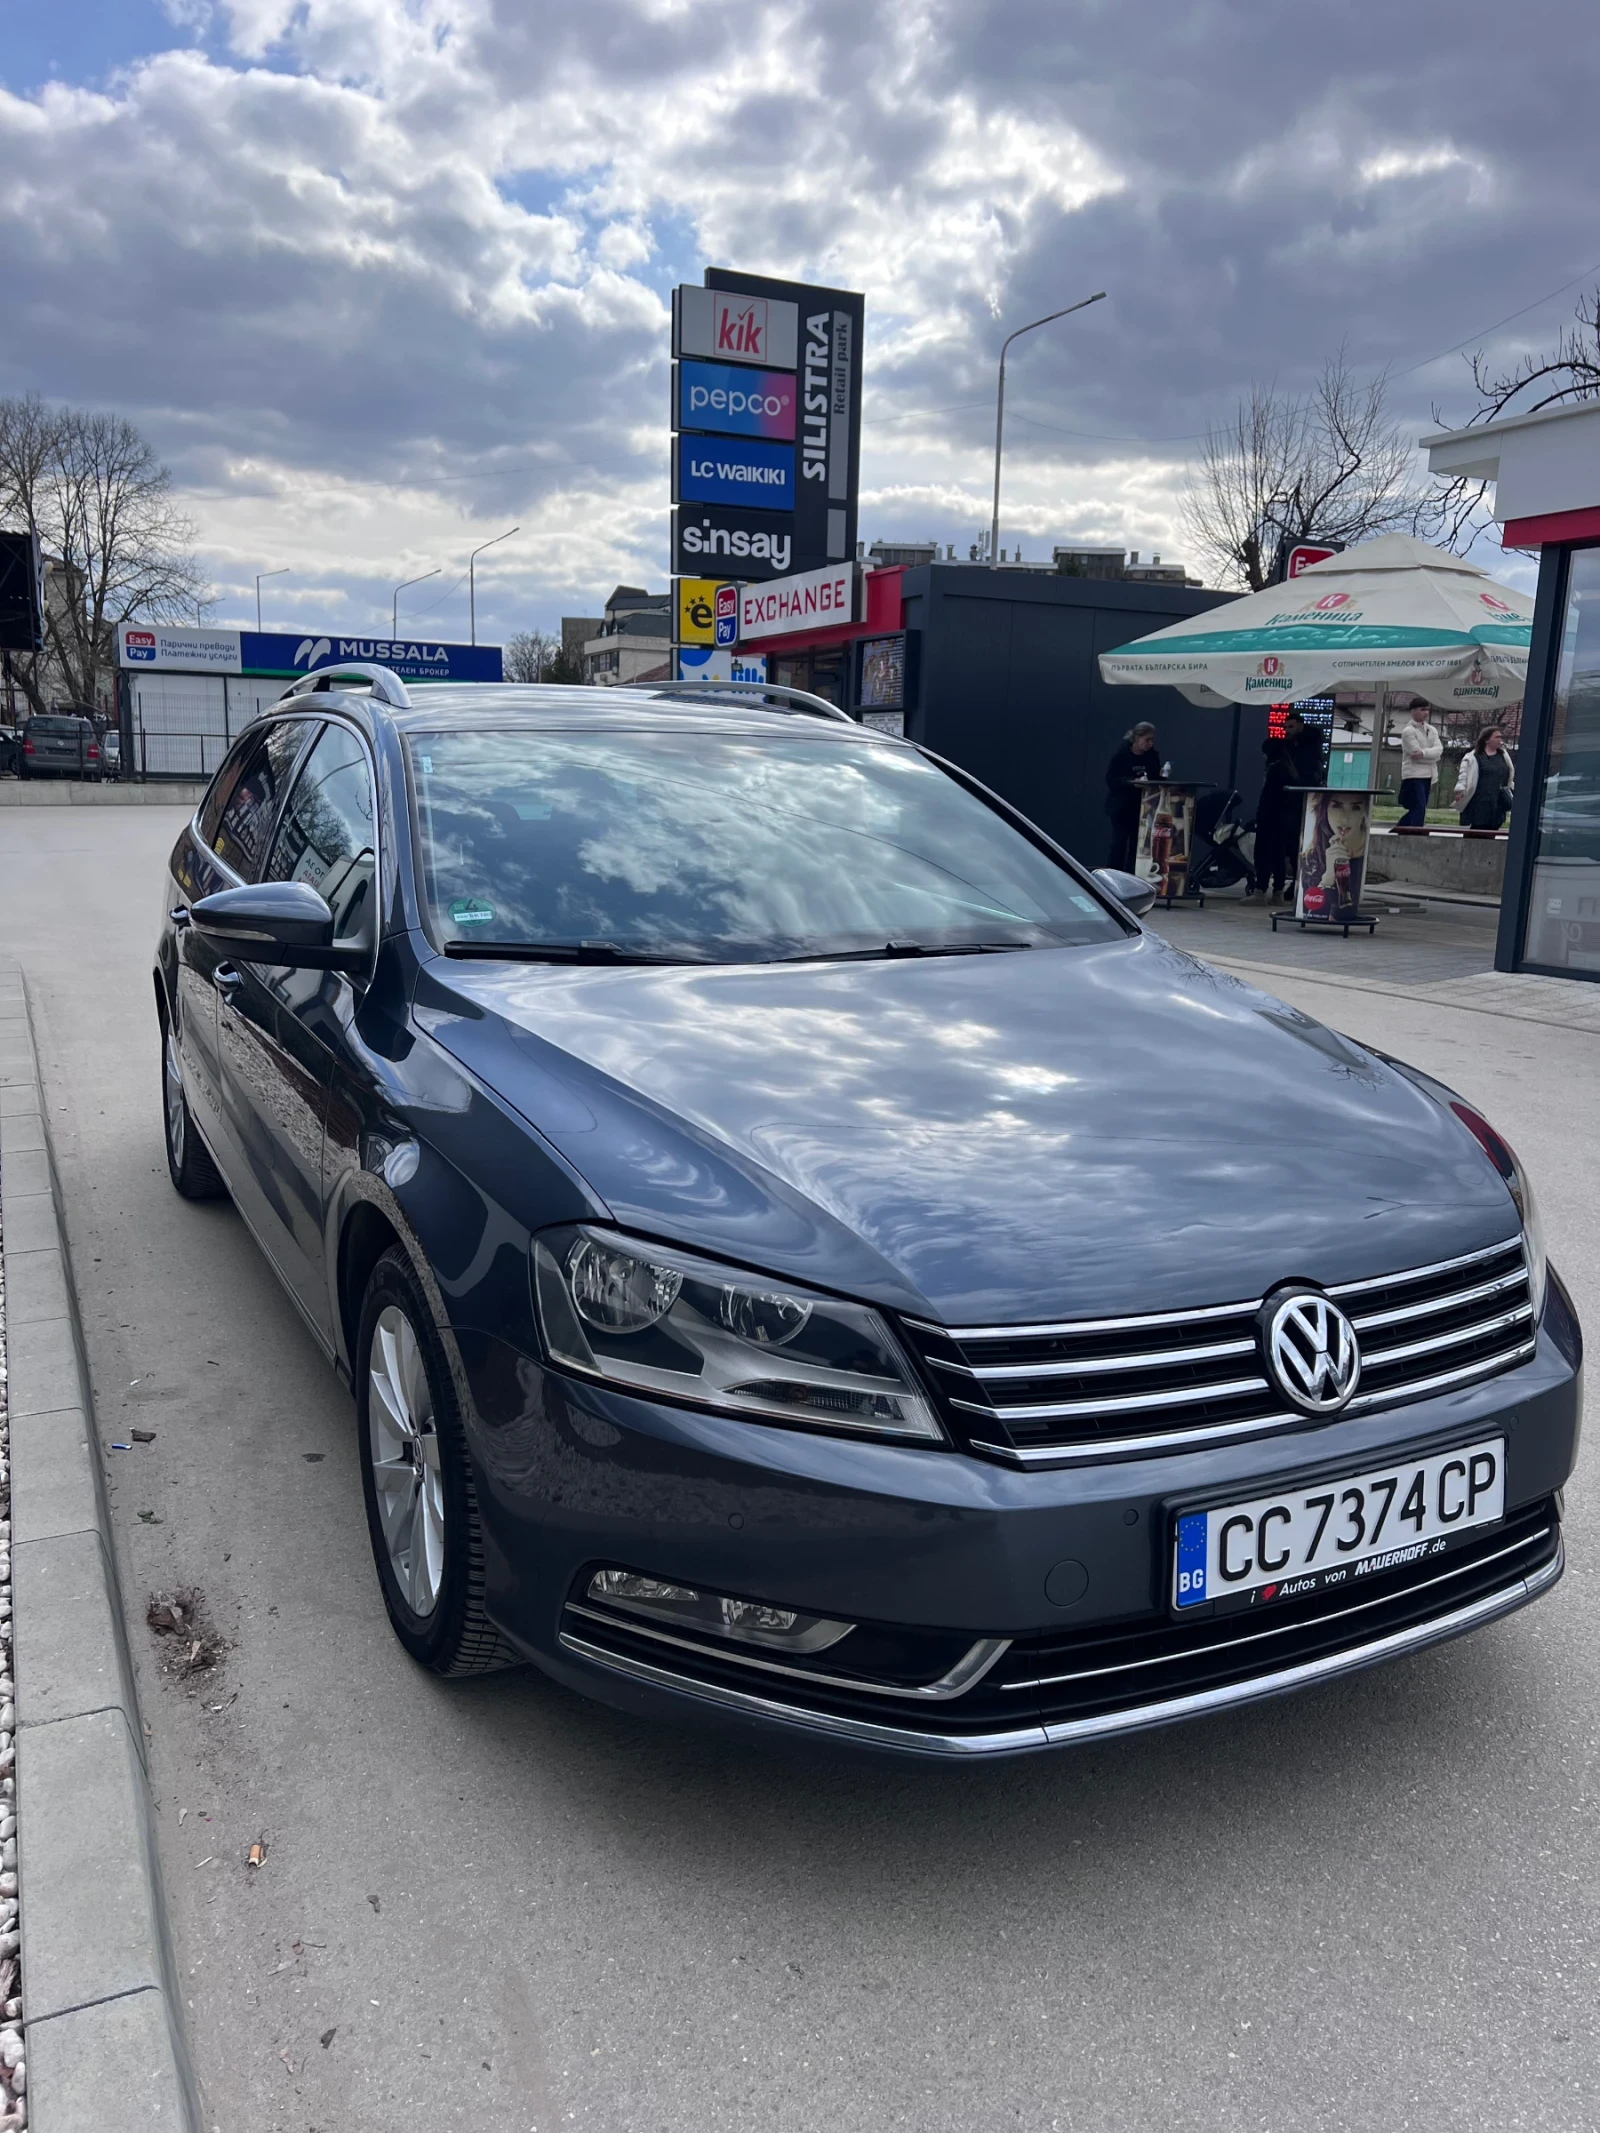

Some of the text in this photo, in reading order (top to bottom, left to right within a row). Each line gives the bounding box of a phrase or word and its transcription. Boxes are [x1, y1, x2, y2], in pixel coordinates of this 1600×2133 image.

[718, 304, 763, 354] kik
[833, 323, 849, 415] Retail park
[802, 312, 830, 482] SILISTRA
[691, 460, 714, 478] LC
[683, 519, 791, 570] sinsay
[719, 598, 735, 614] Easy
[744, 579, 846, 625] EXCHANGE
[1264, 611, 1364, 626] Каменица
[718, 621, 732, 639] Pay
[129, 634, 152, 646] Easy
[160, 639, 236, 652] Парични преводи
[130, 648, 148, 659] Pay
[161, 648, 238, 662] Платежни услуги
[340, 640, 449, 662] MUSSALA
[419, 667, 450, 676] БРОКЕР
[1435, 659, 1447, 667] ОТ
[1245, 676, 1292, 691] Каменица
[1179, 1568, 1204, 1593] BG
[1279, 1577, 1316, 1597] Autos
[1325, 1569, 1347, 1585] von
